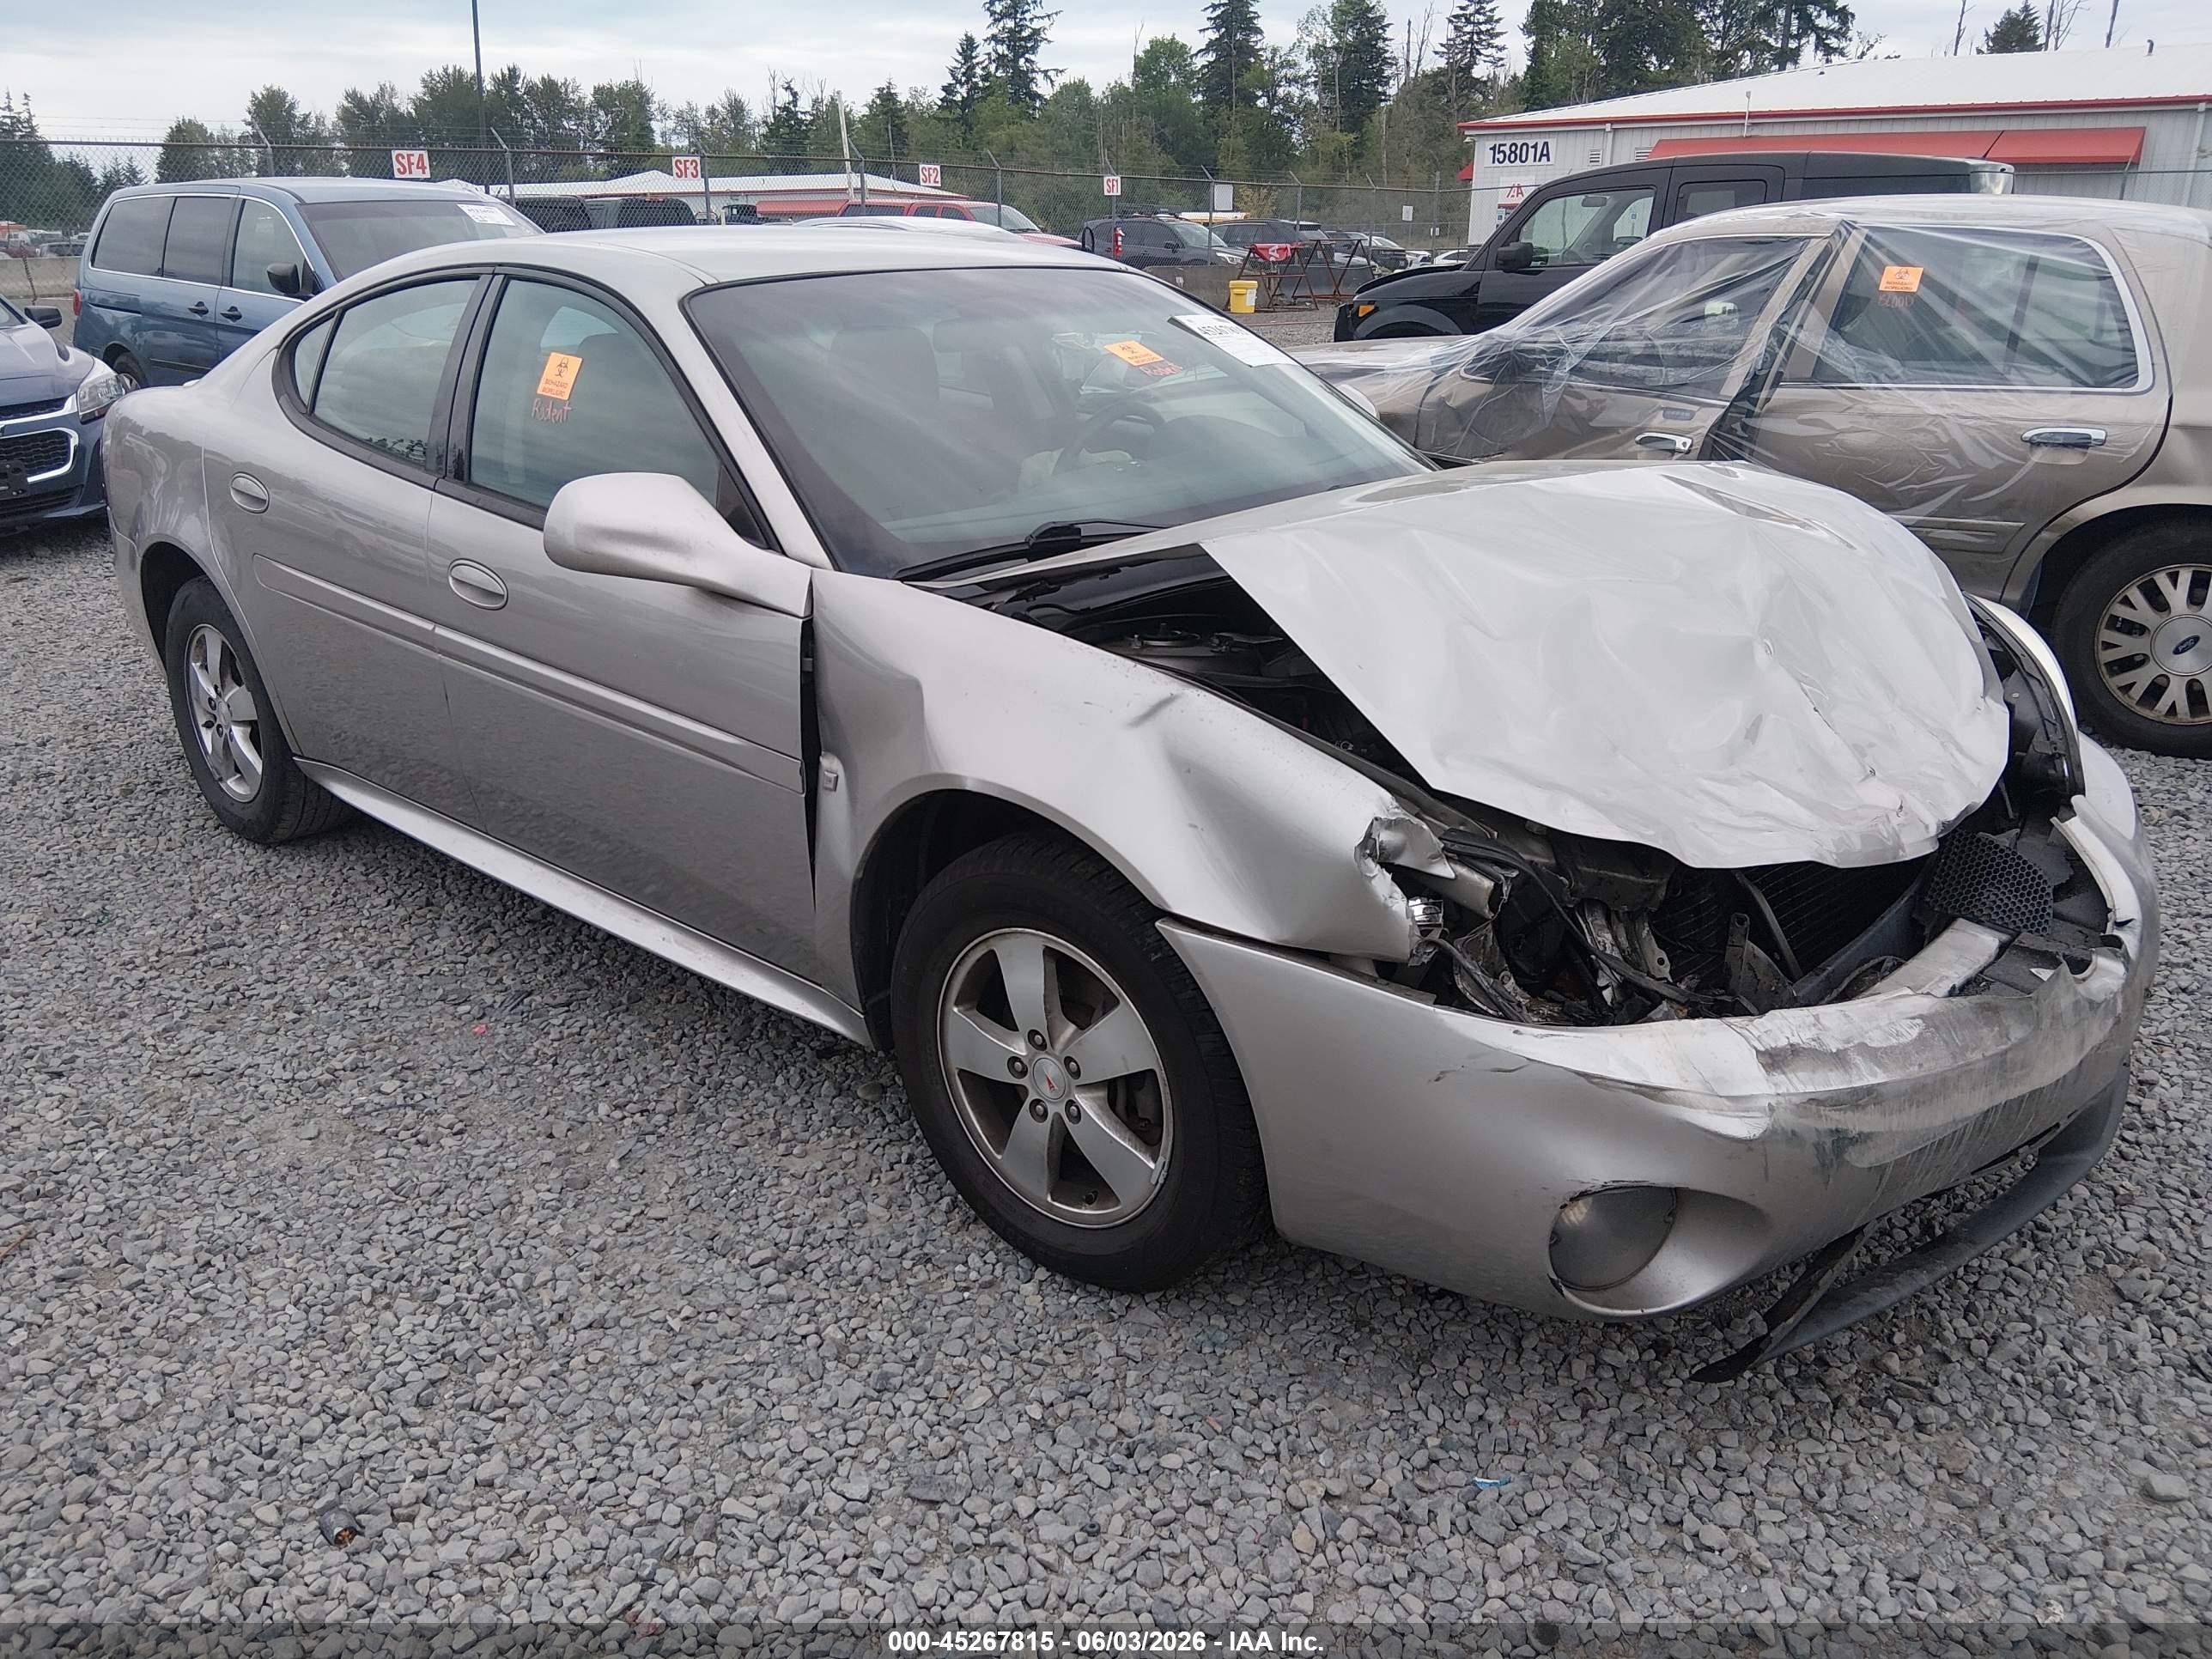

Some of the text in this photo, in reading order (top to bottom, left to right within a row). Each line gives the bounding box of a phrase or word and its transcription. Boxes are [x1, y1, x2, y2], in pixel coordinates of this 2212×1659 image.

[1489, 141, 1551, 164] 15801A
[395, 152, 428, 175] SF4
[674, 159, 699, 179] SF3
[921, 166, 939, 184] SF2
[1106, 178, 1119, 193] SF1
